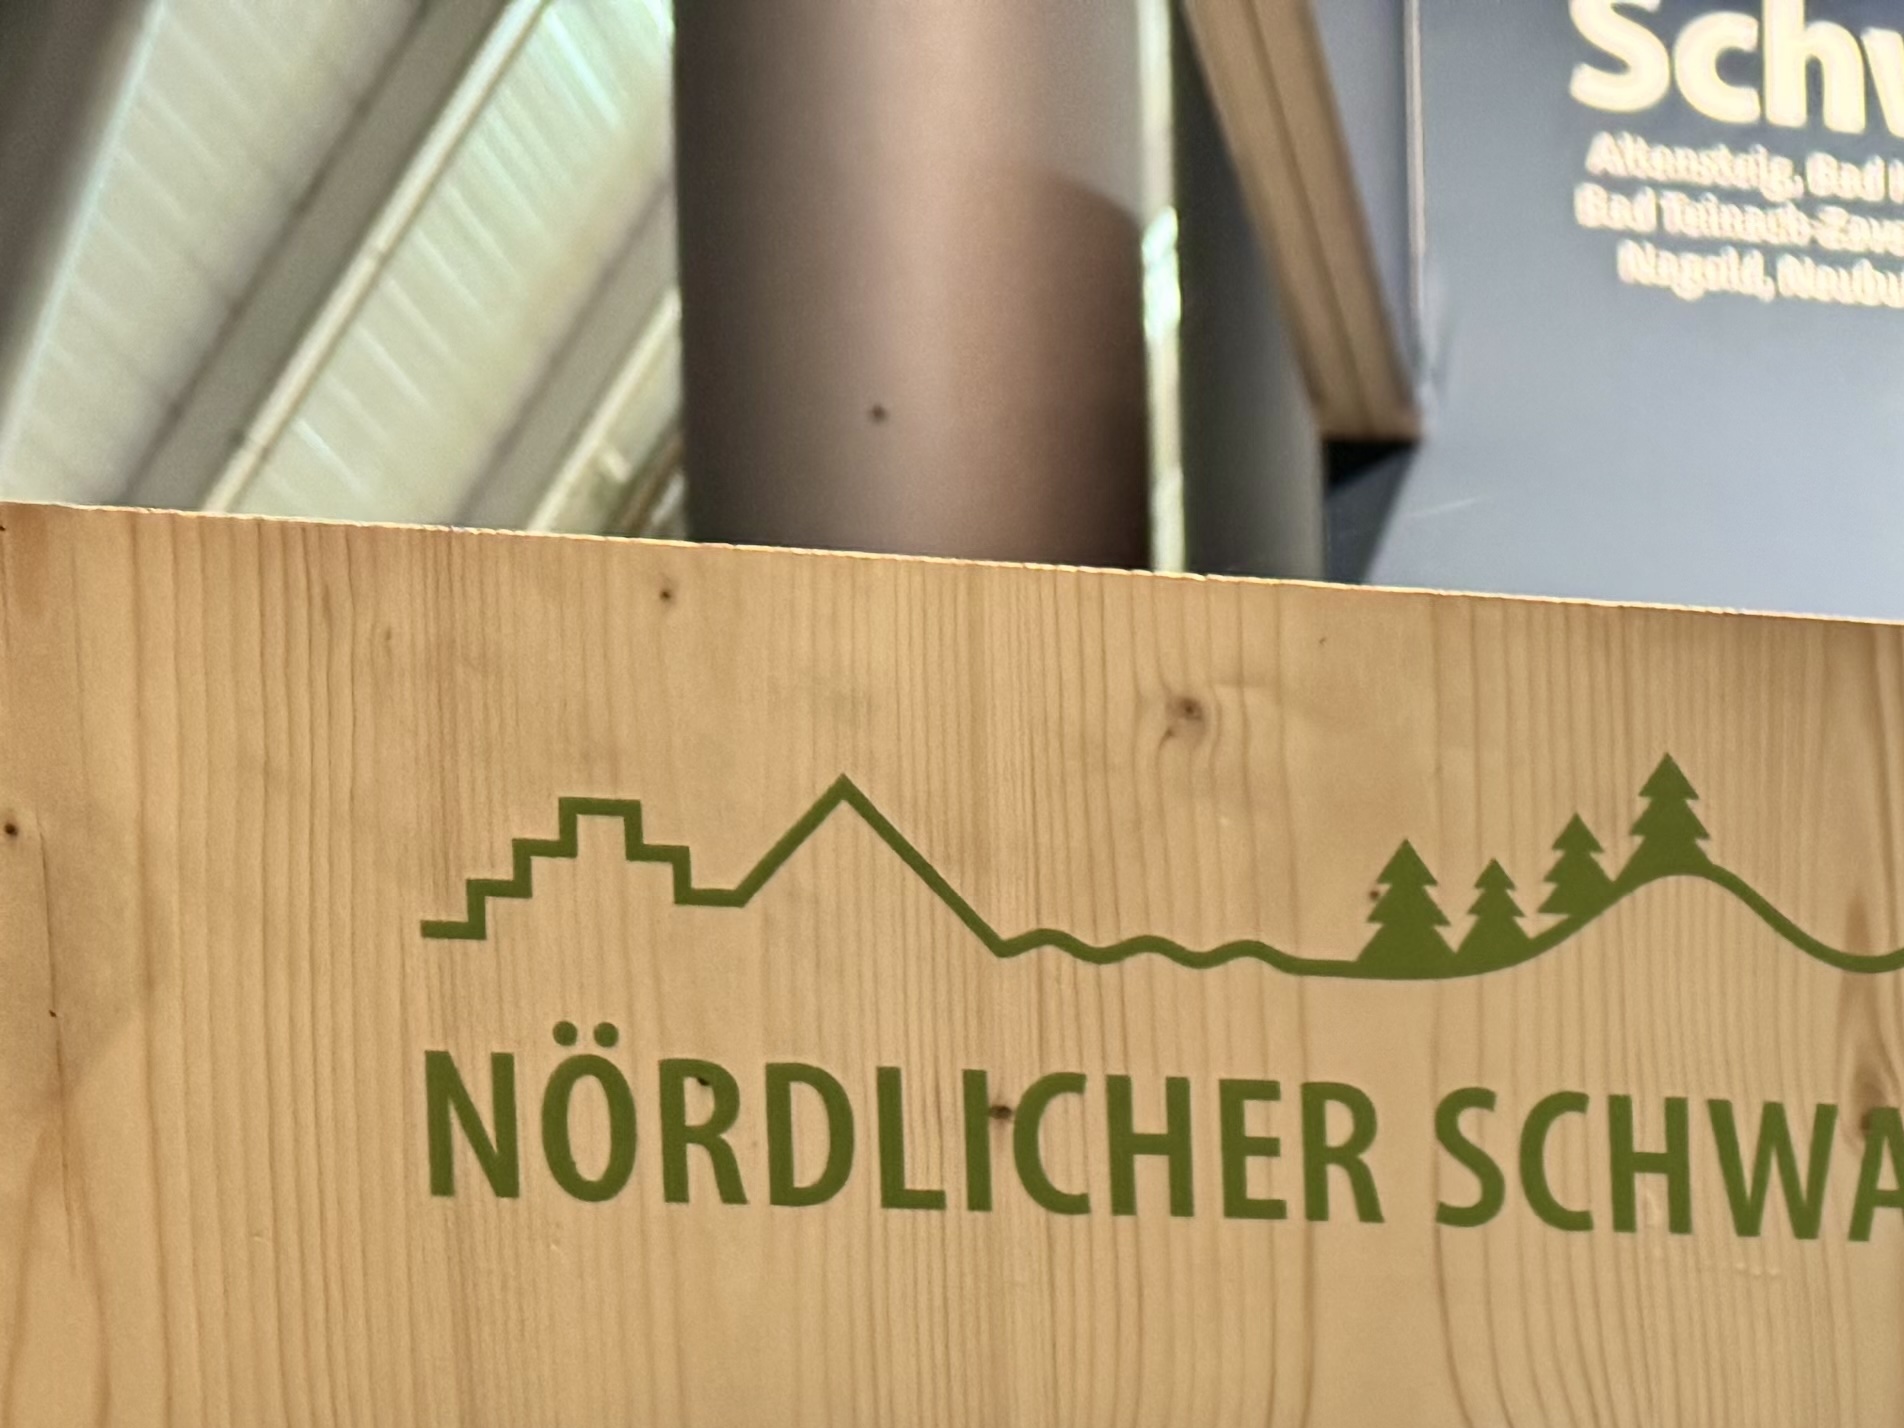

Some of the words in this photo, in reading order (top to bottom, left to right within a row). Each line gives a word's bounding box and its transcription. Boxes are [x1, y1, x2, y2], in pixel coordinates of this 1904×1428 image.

[1806, 152, 1885, 202] Bad
[1574, 183, 1656, 233] Bad
[423, 1019, 1383, 1225] NÖRDLICHER
